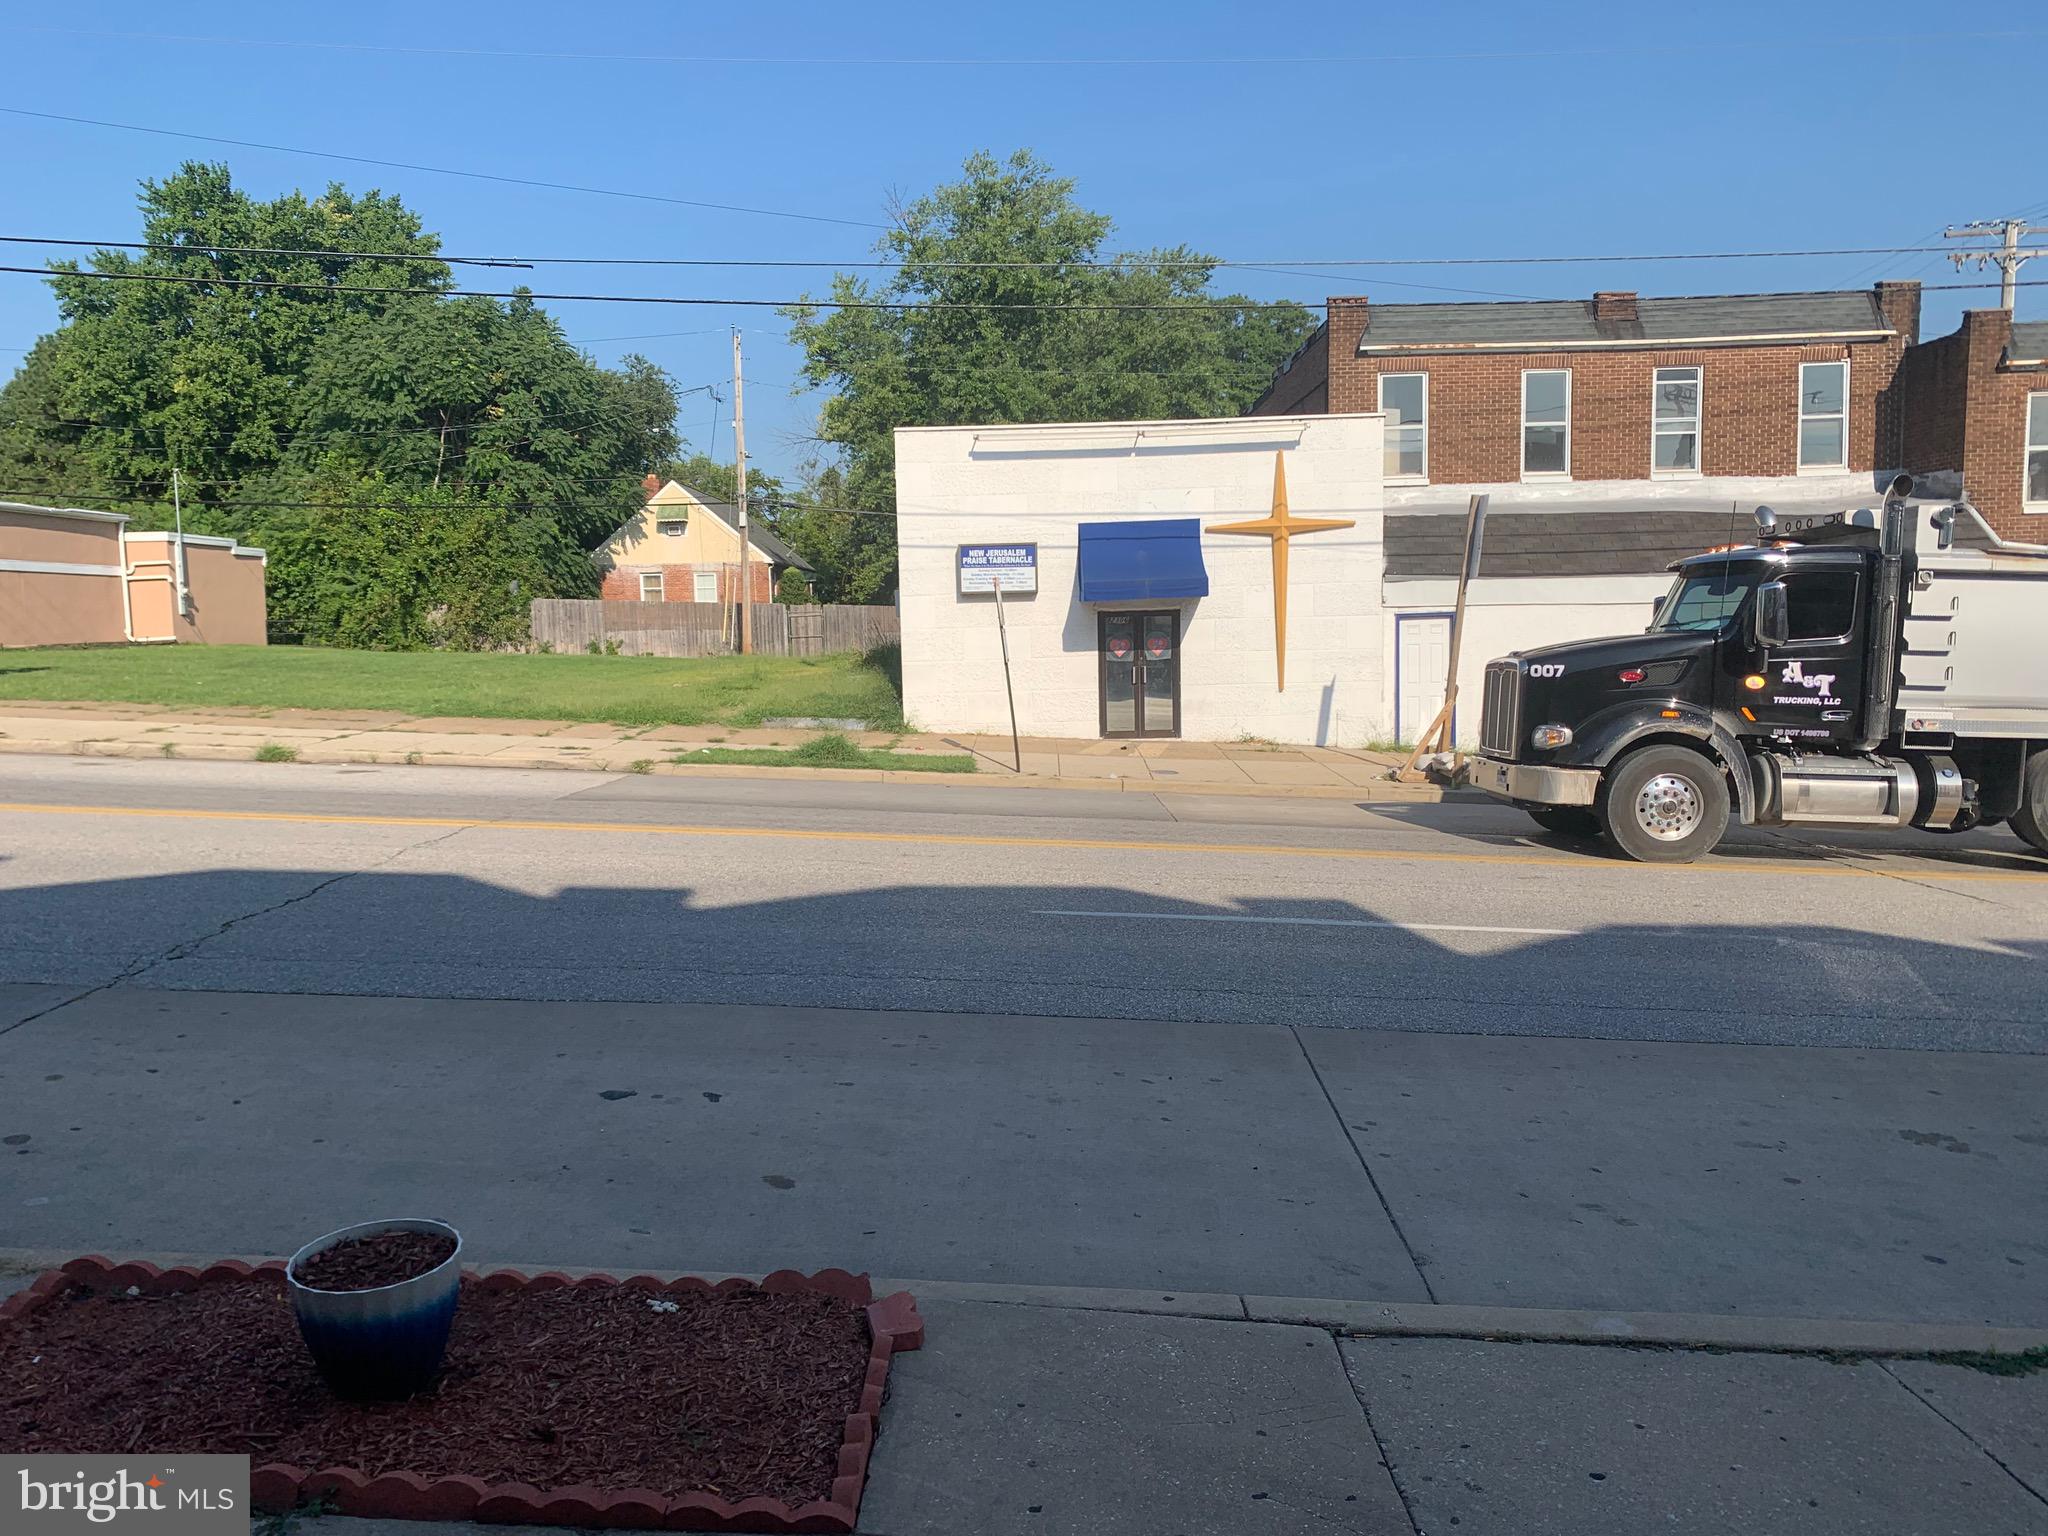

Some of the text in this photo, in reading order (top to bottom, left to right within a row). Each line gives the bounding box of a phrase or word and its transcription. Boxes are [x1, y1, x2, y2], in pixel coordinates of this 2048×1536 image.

[969, 549, 1026, 557] NEW JERUSALEM
[989, 556, 1032, 564] TABERNACLE
[1529, 664, 1566, 678] 007
[1782, 661, 1836, 696] A&T
[1773, 696, 1842, 706] TRUCKING, LLC
[1784, 729, 1800, 737] DOT
